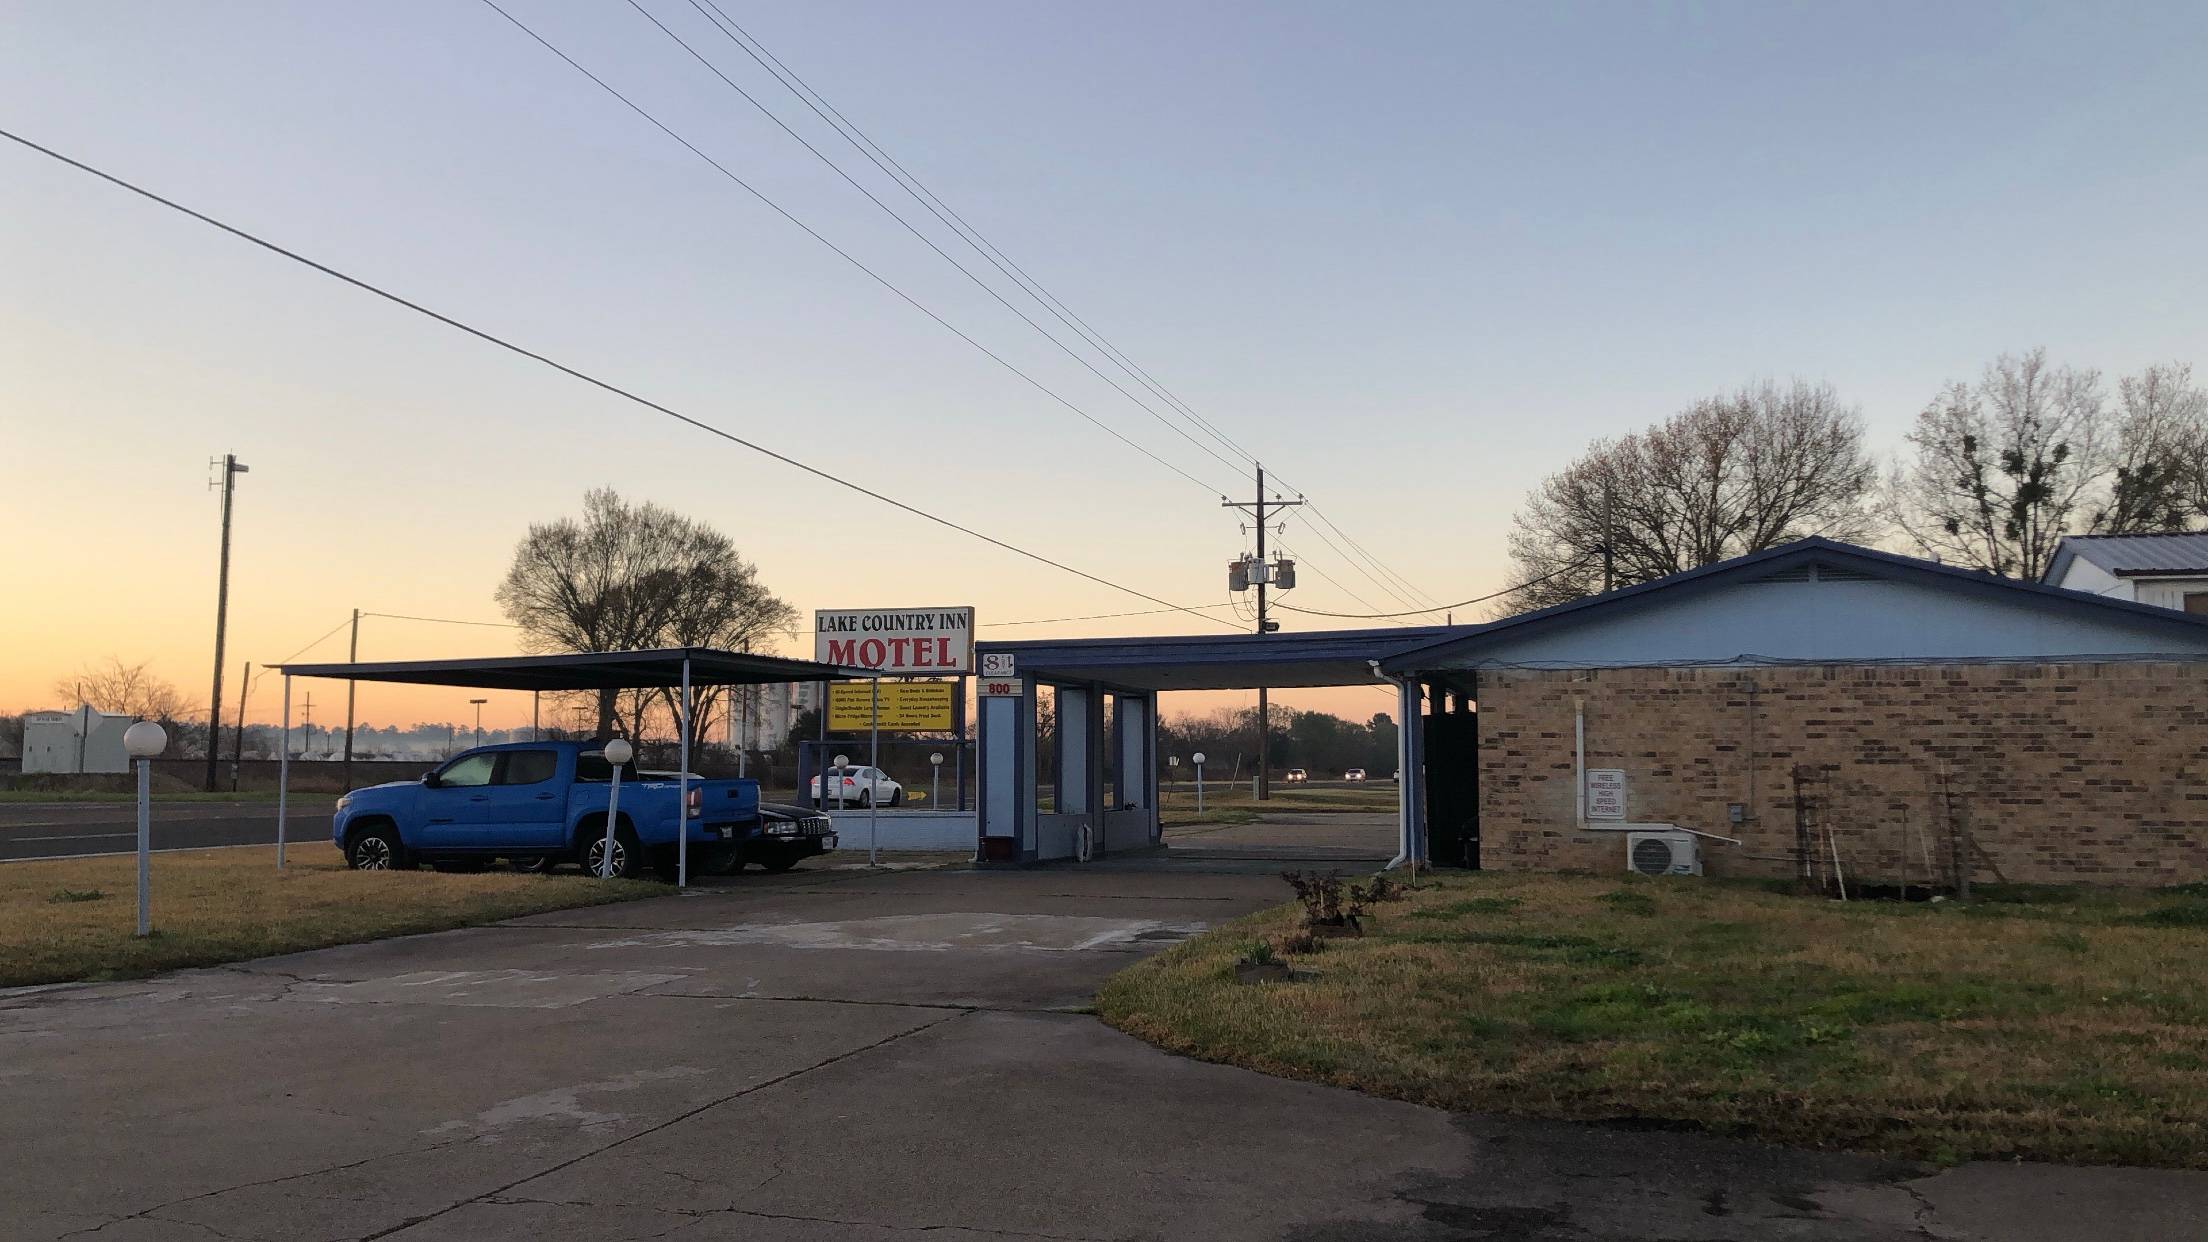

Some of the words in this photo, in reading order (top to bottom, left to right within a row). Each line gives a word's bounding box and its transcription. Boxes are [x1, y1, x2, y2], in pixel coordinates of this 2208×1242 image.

[818, 615, 857, 632] LAKE
[861, 613, 935, 631] COUNTRY
[940, 612, 967, 630] INN
[828, 637, 957, 667] MOTEL
[988, 683, 1010, 694] 800
